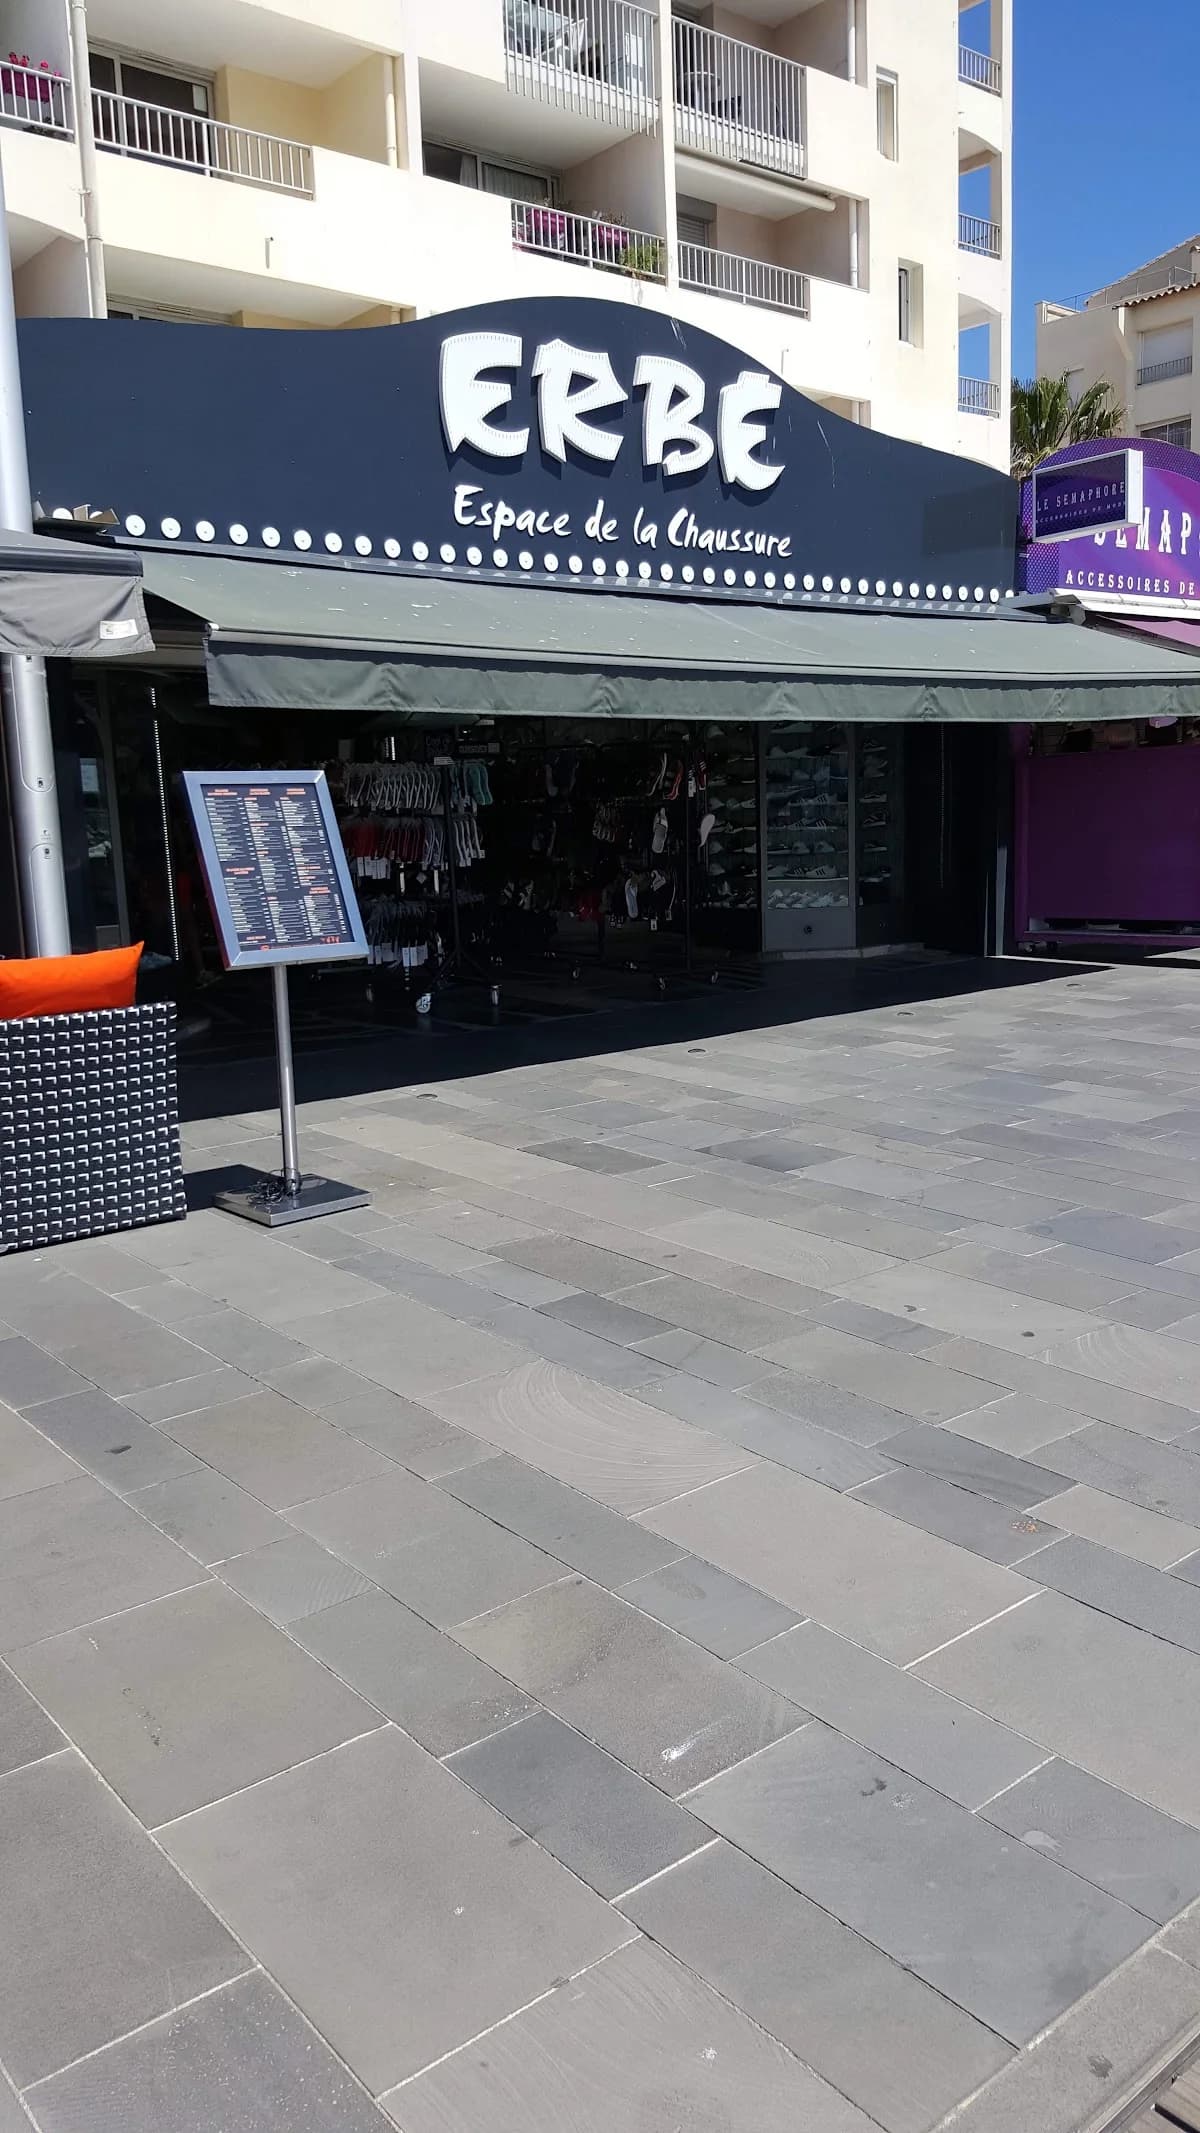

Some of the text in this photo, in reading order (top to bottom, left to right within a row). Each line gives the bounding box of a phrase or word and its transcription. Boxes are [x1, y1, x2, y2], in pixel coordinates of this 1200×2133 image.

[1037, 481, 1125, 512] LE SEMAPHORE
[454, 485, 793, 559] Espace de la Chaussure
[1065, 569, 1195, 596] ACCESSOIRES DE
